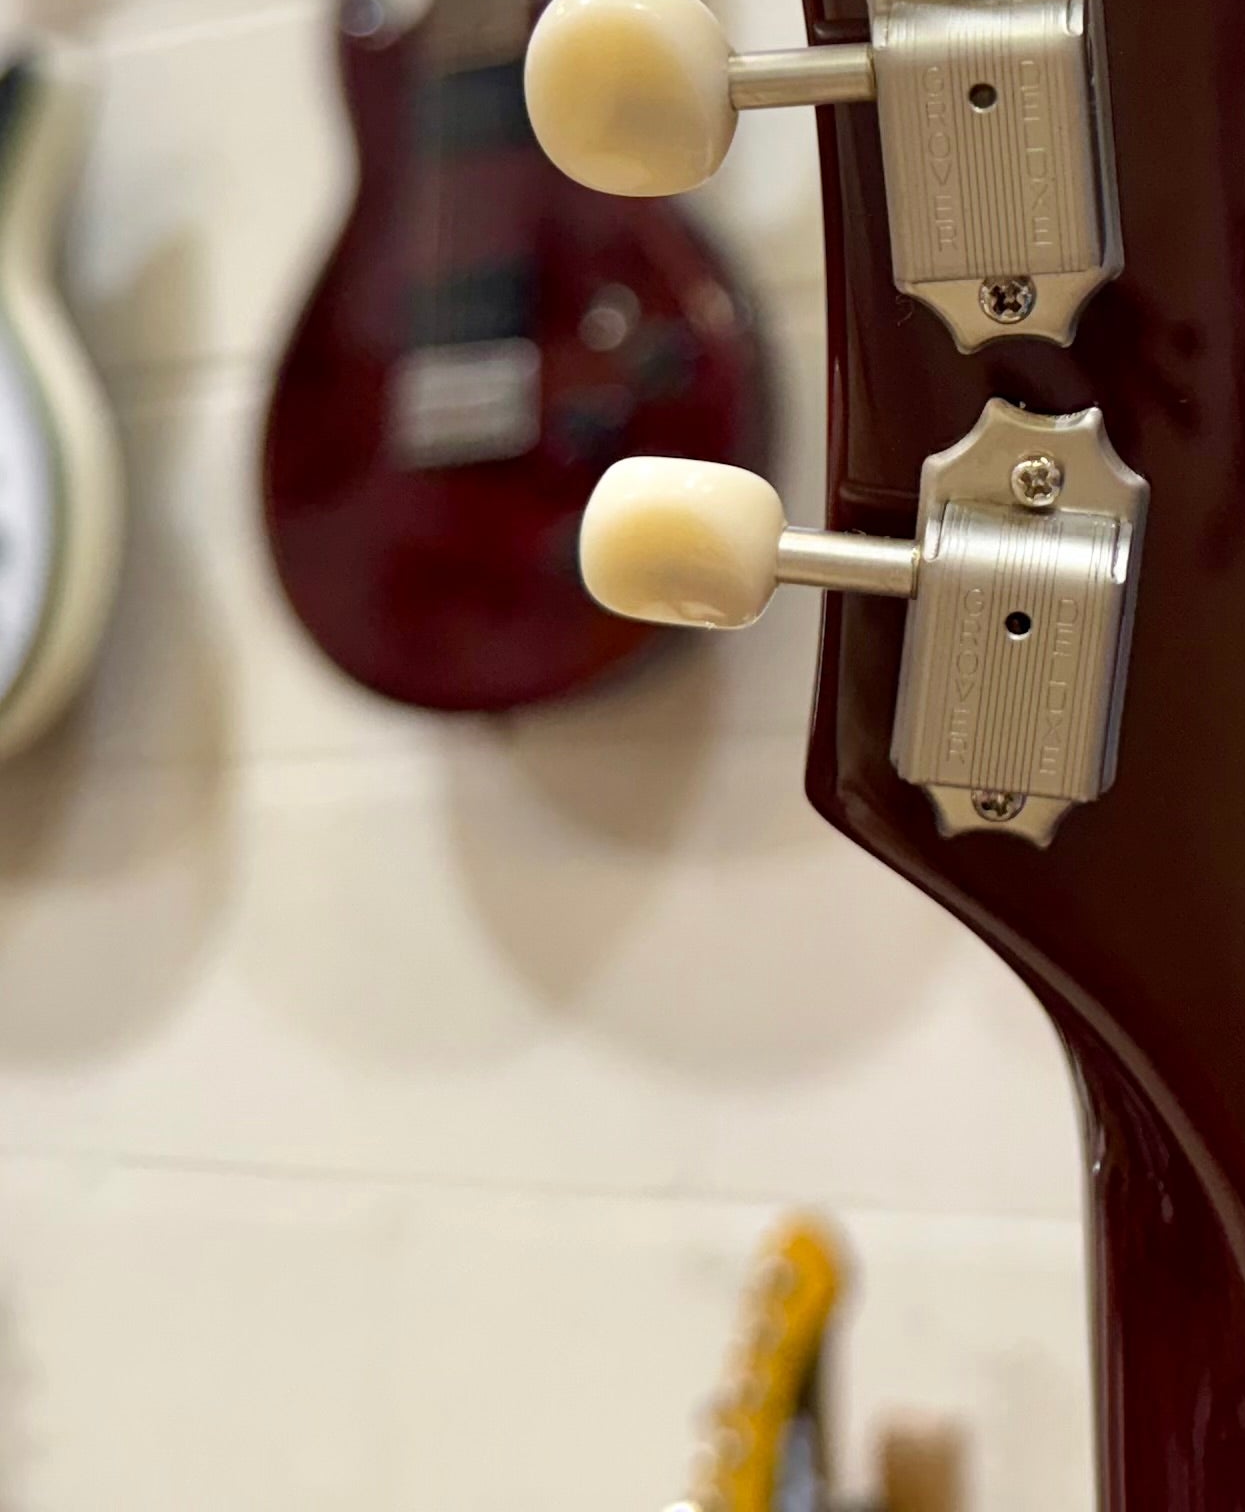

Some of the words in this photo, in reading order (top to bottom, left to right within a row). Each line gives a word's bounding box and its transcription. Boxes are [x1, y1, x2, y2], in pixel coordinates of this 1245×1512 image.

[921, 64, 960, 253] GROVER
[1018, 58, 1055, 249] DELUXE
[945, 586, 986, 765] GROVER
[1038, 597, 1080, 777] DELUXE
